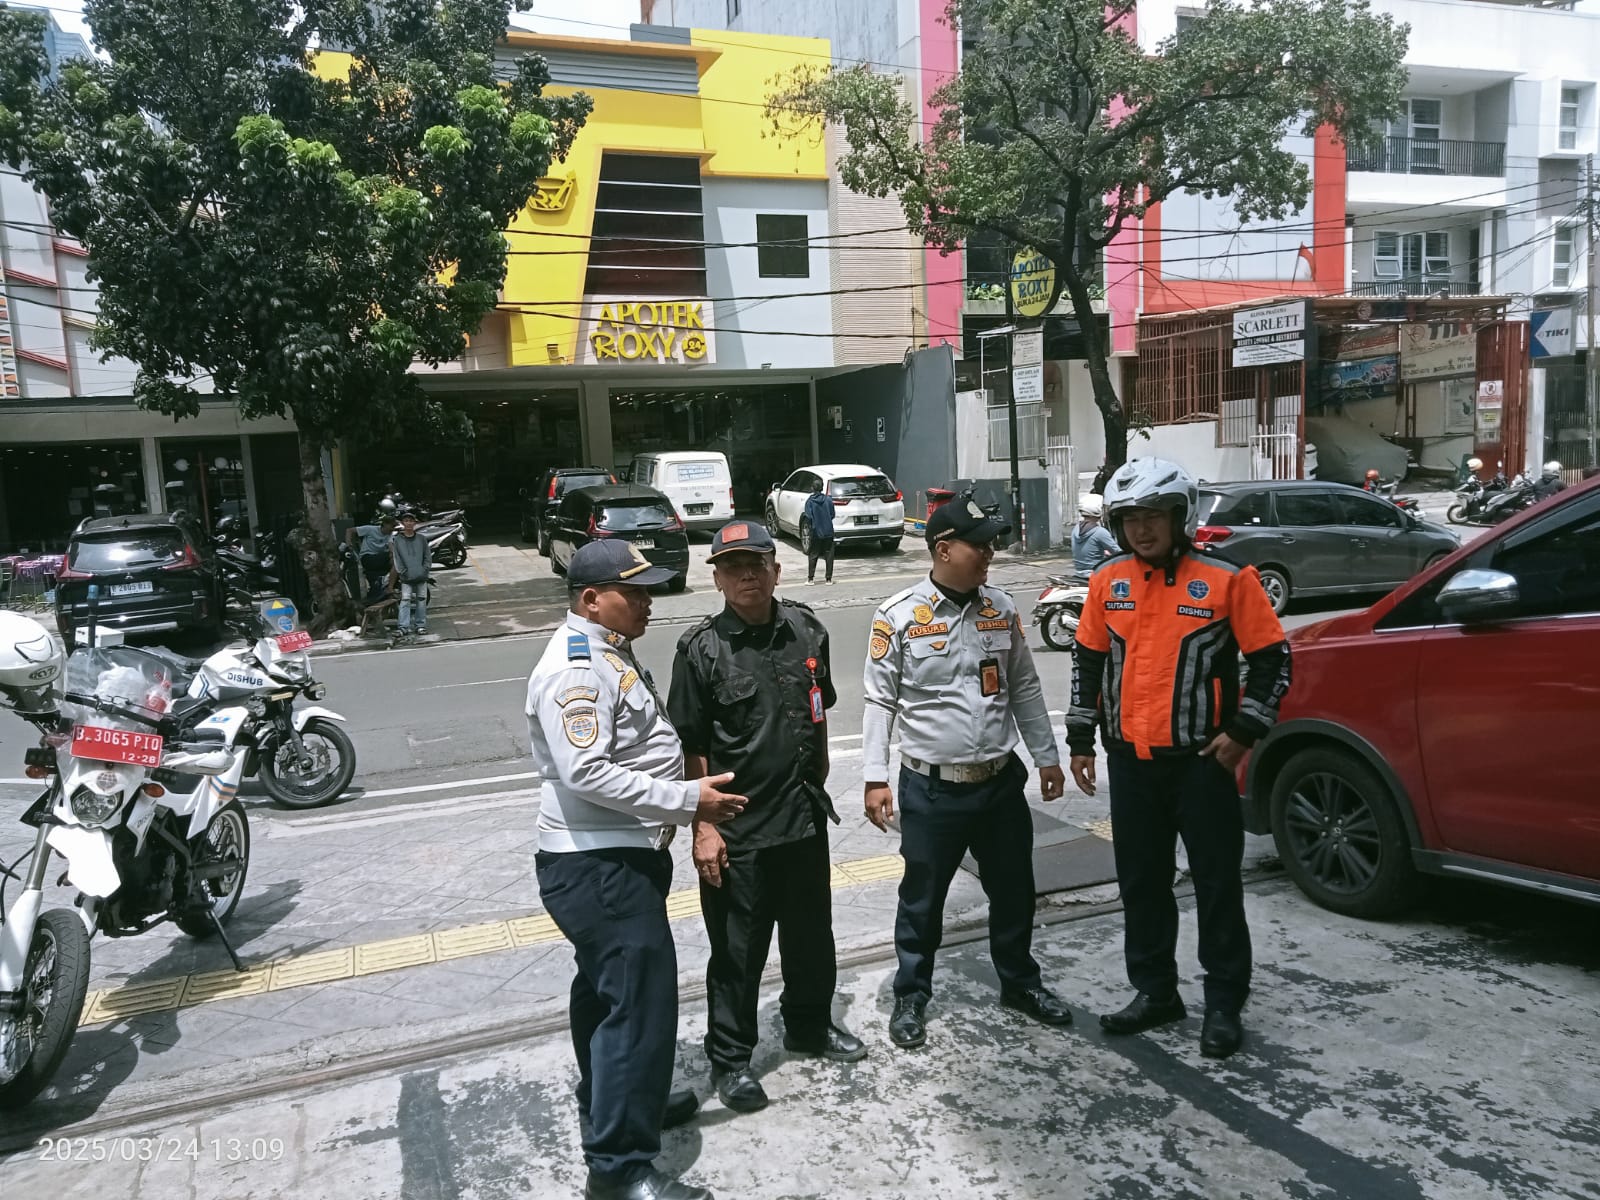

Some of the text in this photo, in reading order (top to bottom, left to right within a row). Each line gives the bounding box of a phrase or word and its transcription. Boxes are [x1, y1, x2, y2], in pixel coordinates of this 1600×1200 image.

[1018, 276, 1049, 298] ROXY
[597, 302, 704, 329] APOTEK
[1238, 314, 1300, 334] SCARLETT
[1545, 328, 1569, 337] TIKI
[590, 331, 676, 359] ROXY
[1179, 606, 1212, 618] DISHUB
[227, 672, 263, 686] DISHUB
[95, 729, 129, 746] 3065
